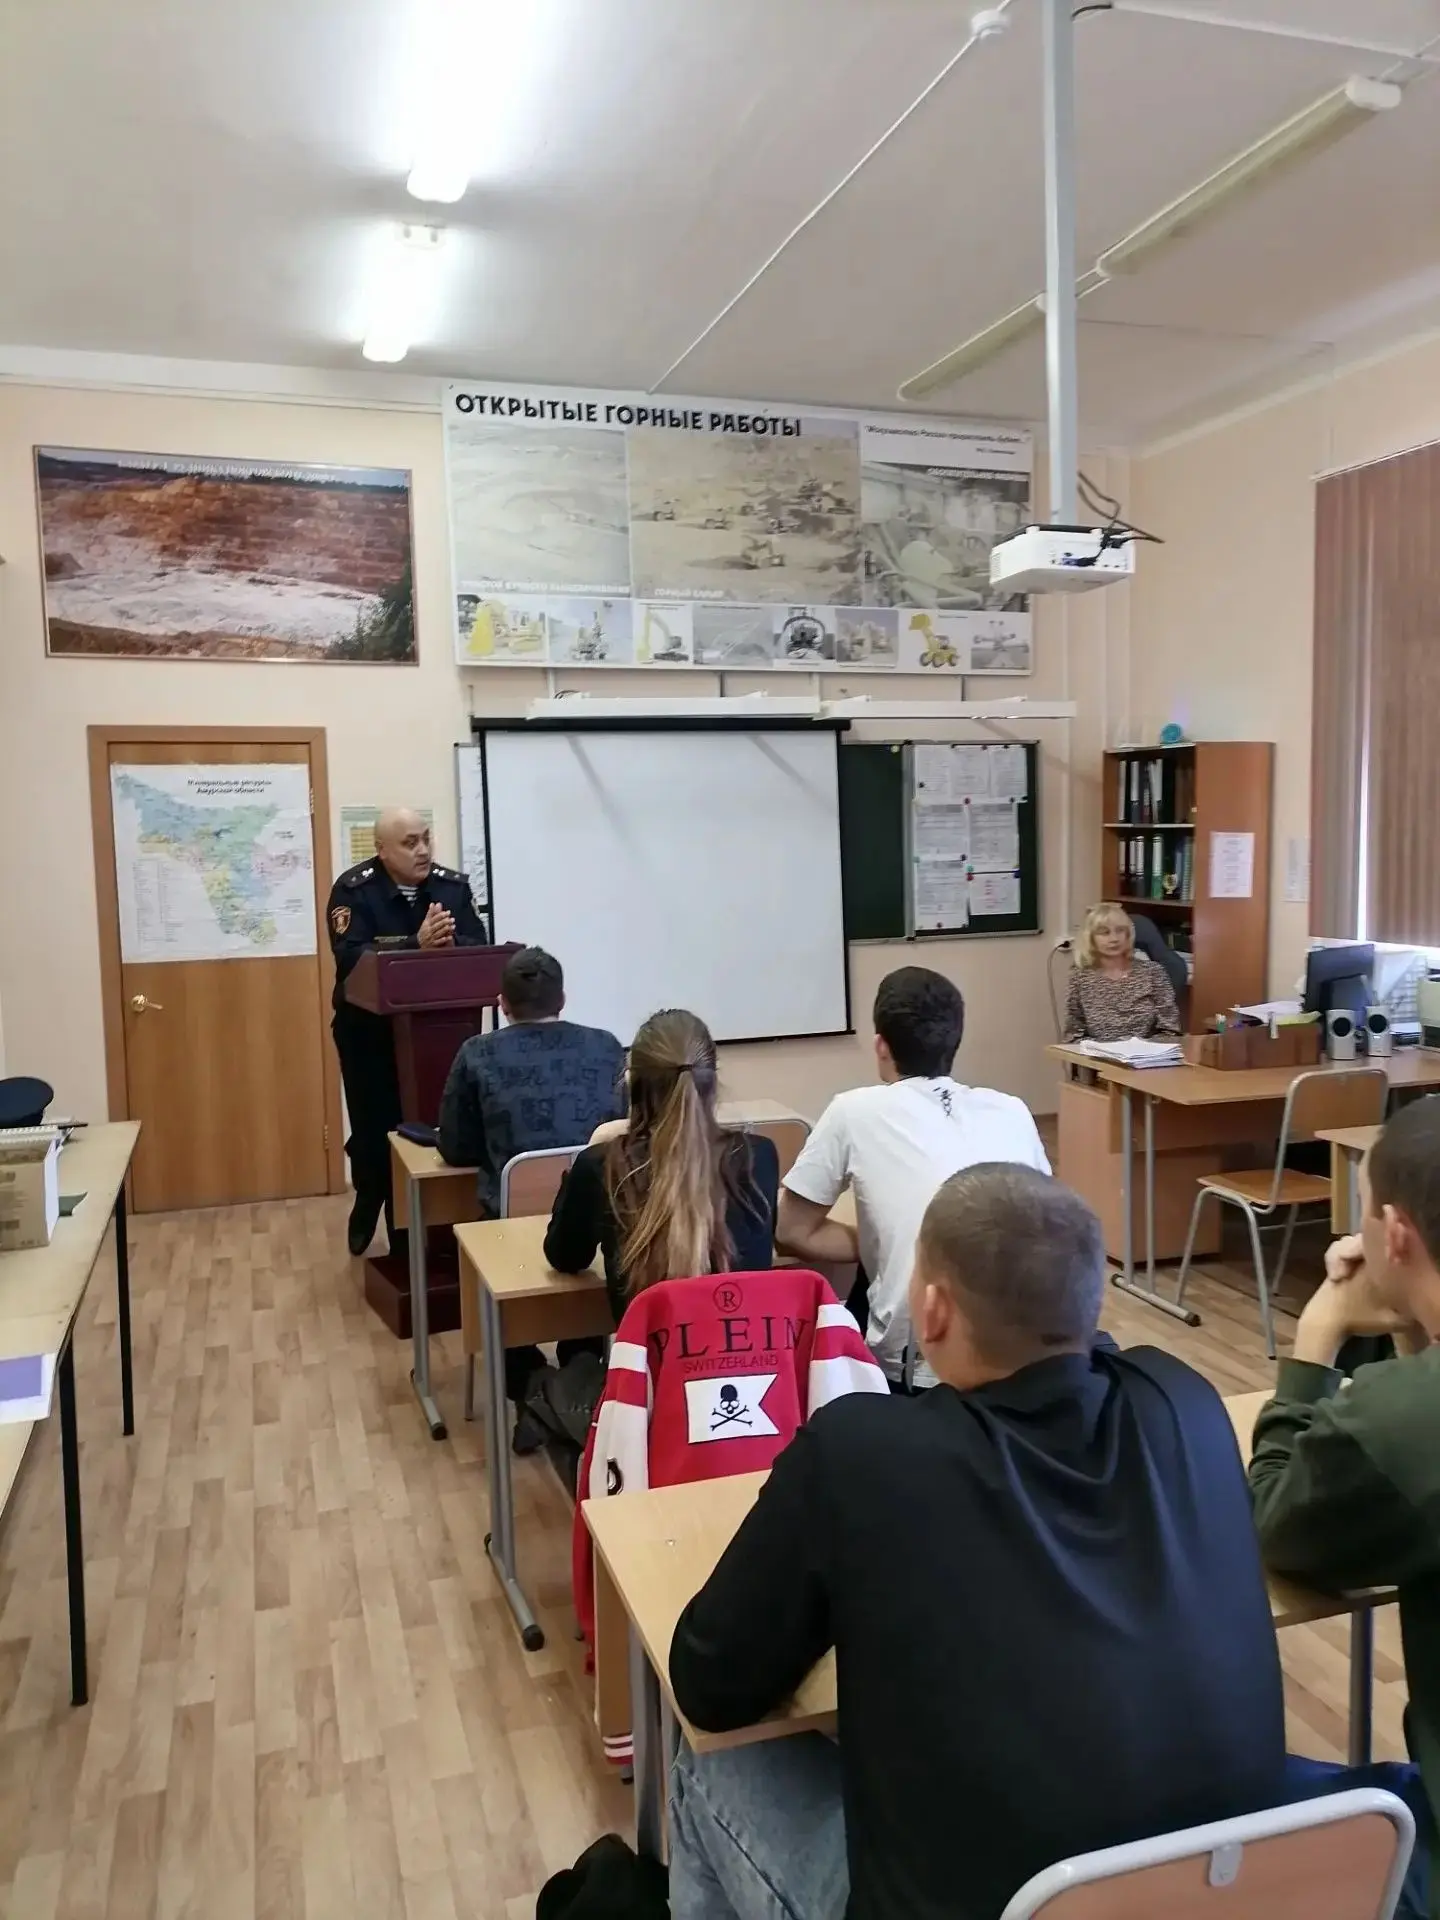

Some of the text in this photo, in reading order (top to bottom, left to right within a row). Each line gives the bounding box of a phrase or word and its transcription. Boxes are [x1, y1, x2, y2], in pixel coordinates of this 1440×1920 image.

[455, 393, 801, 437] ОТКРЫТЫЕ ГОРНЫЕ РАБОТЫ
[647, 1315, 811, 1365] PLEIN
[682, 1354, 779, 1373] SWITZERLAND
